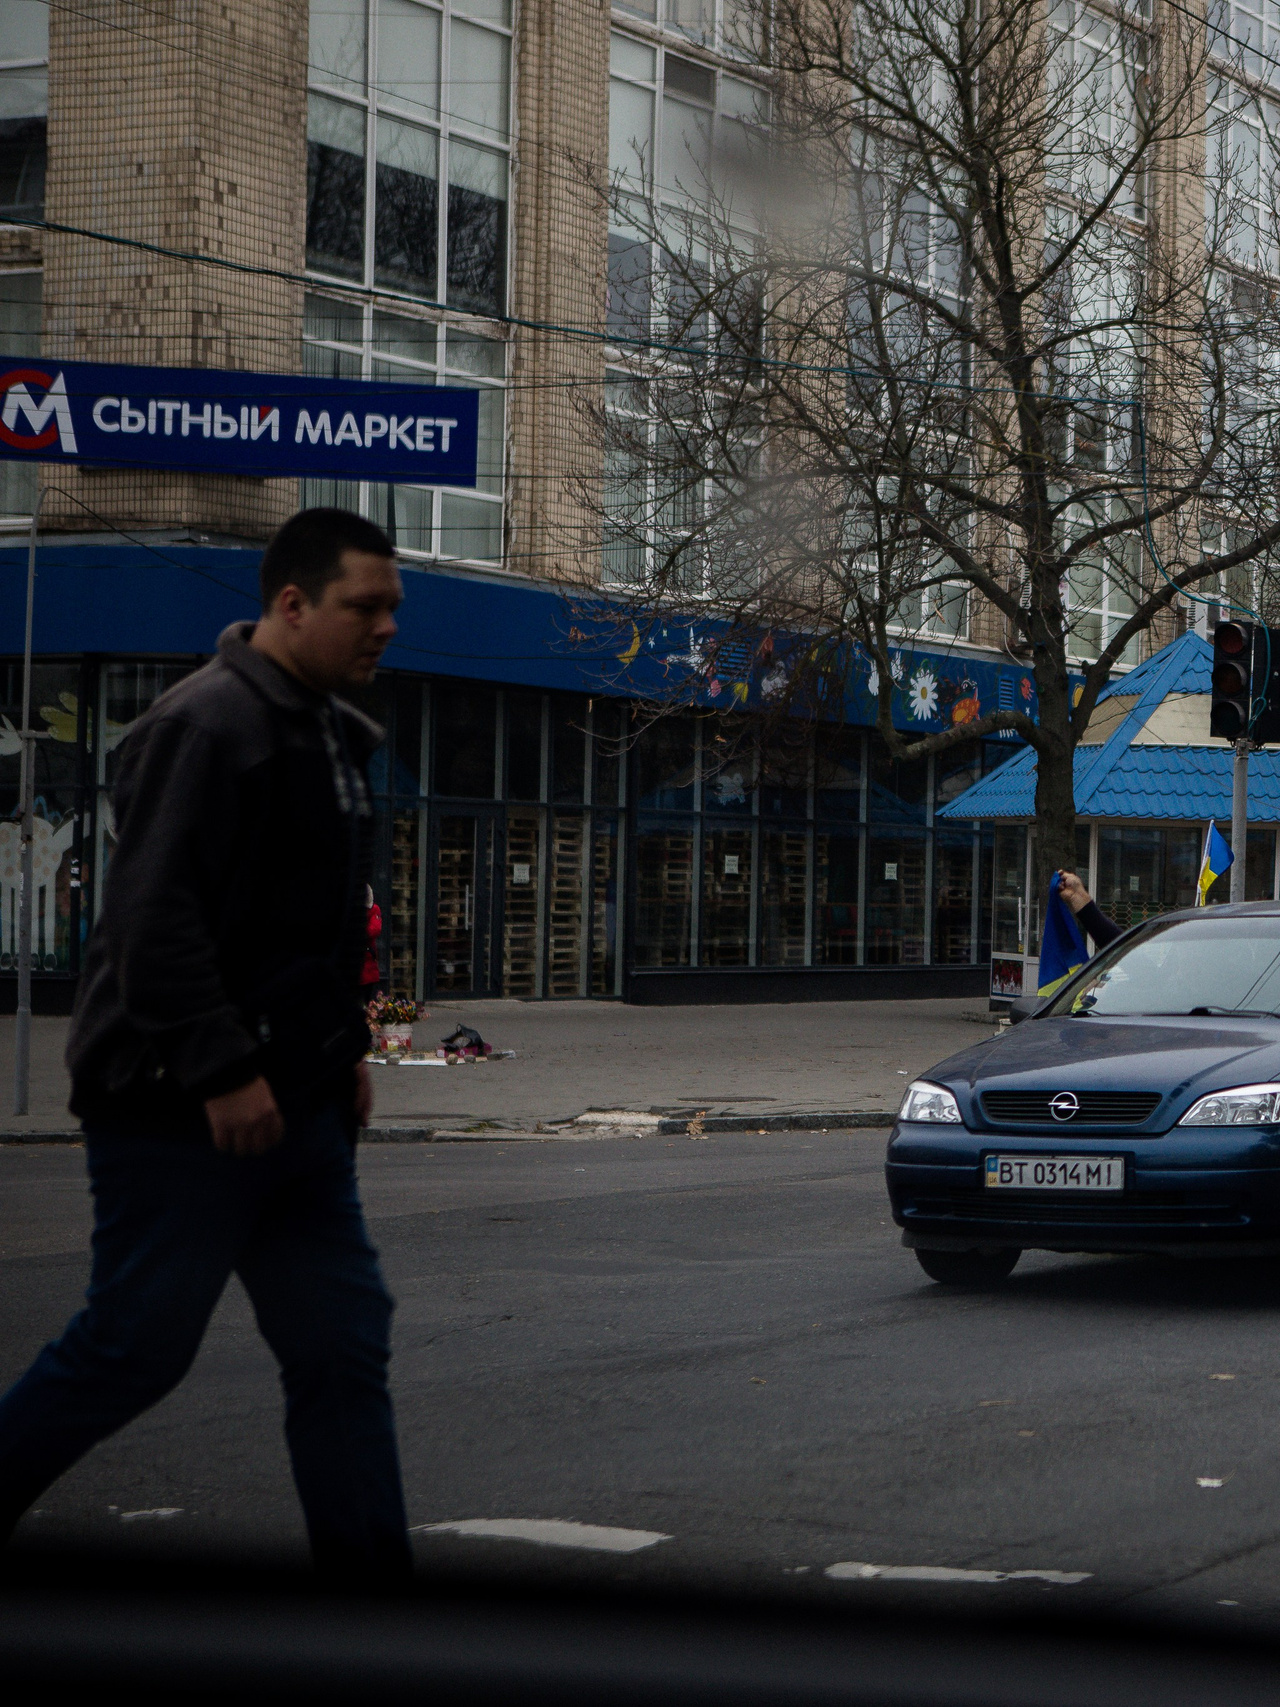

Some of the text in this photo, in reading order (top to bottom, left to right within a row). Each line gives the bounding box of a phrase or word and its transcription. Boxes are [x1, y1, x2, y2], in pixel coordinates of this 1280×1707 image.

[92, 395, 459, 454] СЫТНЫЙ МАРКЕТ
[999, 1161, 1113, 1187] BT 0314 MI
